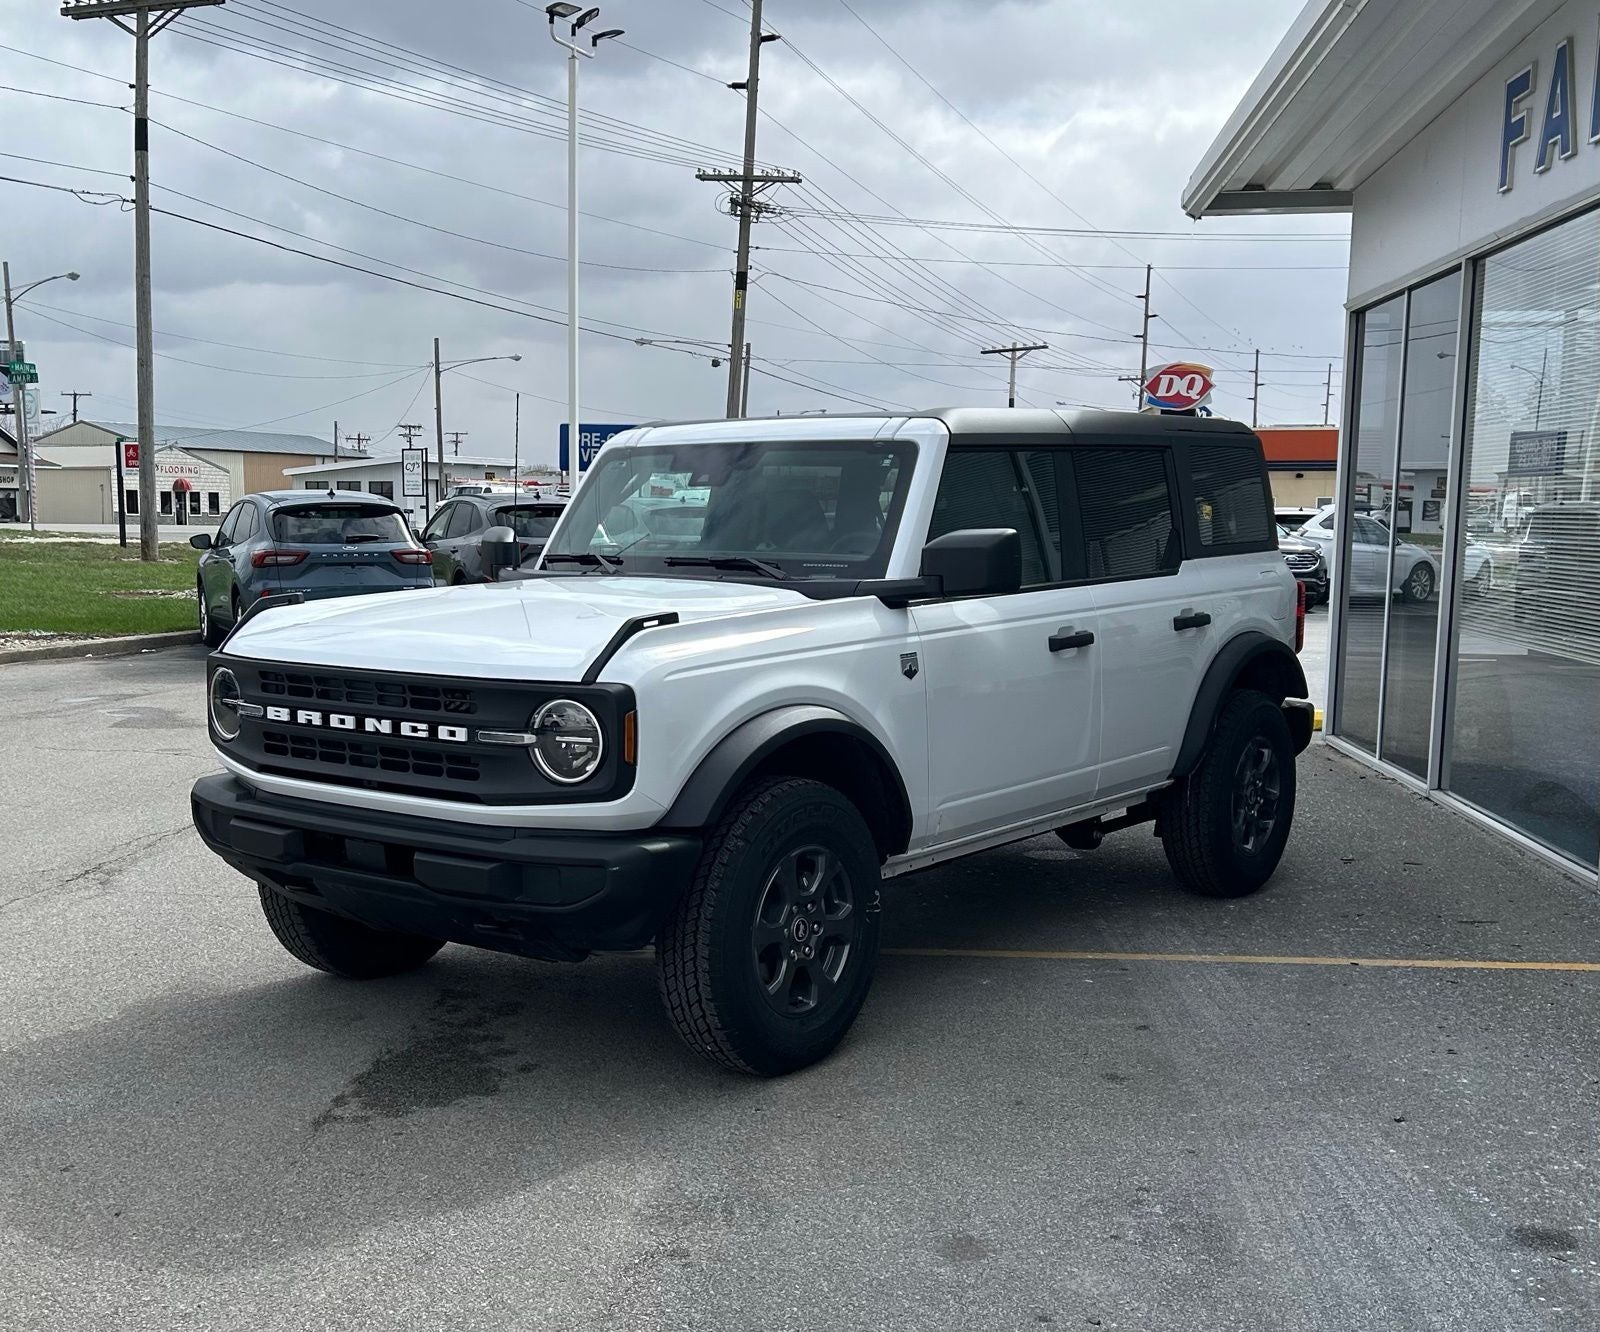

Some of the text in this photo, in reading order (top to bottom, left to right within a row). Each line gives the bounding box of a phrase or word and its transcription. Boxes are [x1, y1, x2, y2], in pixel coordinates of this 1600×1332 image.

[14, 363, 30, 372] MAIN
[8, 374, 31, 383] LAMAR
[1156, 374, 1203, 399] DQ
[579, 432, 615, 447] RE-
[160, 465, 199, 475] FLOORING
[0, 476, 15, 484] SHOP
[266, 706, 468, 742] BRONCO
